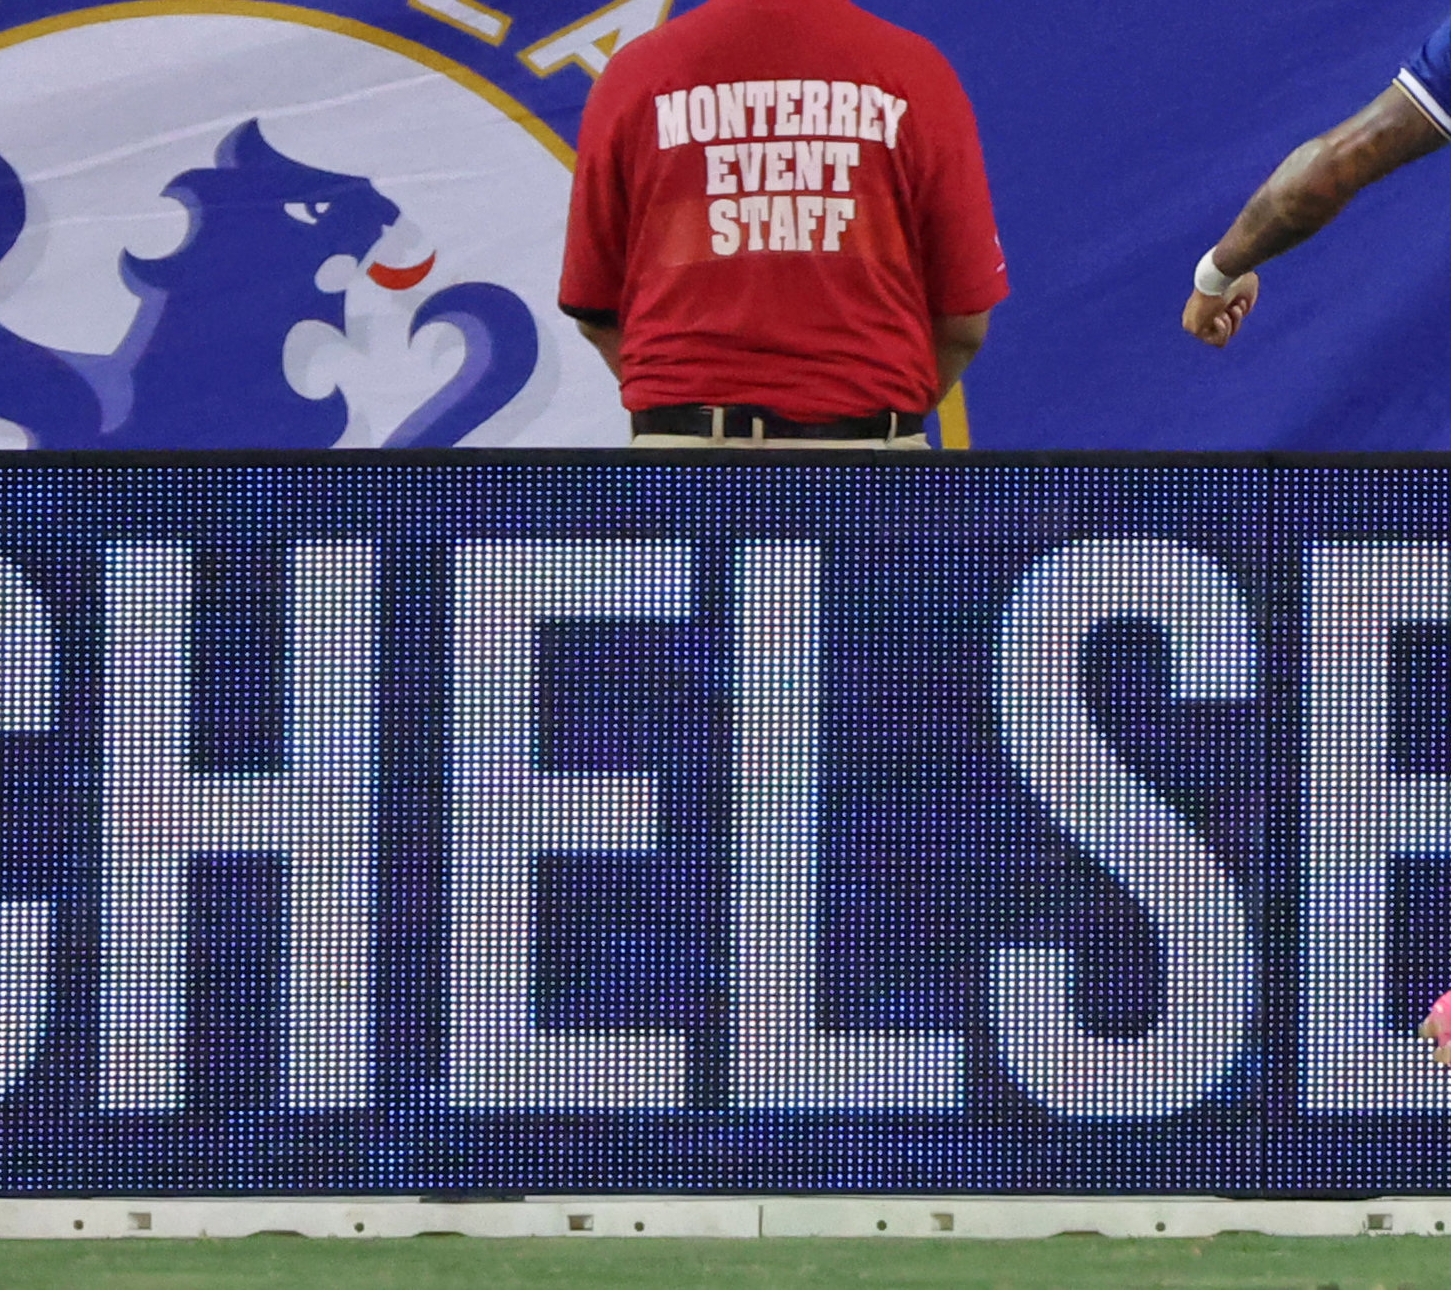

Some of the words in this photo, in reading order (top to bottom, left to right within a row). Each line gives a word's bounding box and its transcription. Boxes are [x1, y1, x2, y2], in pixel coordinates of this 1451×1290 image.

[655, 79, 908, 150] MONTERREY
[705, 140, 860, 195] EVENT
[709, 195, 856, 256] STAFF
